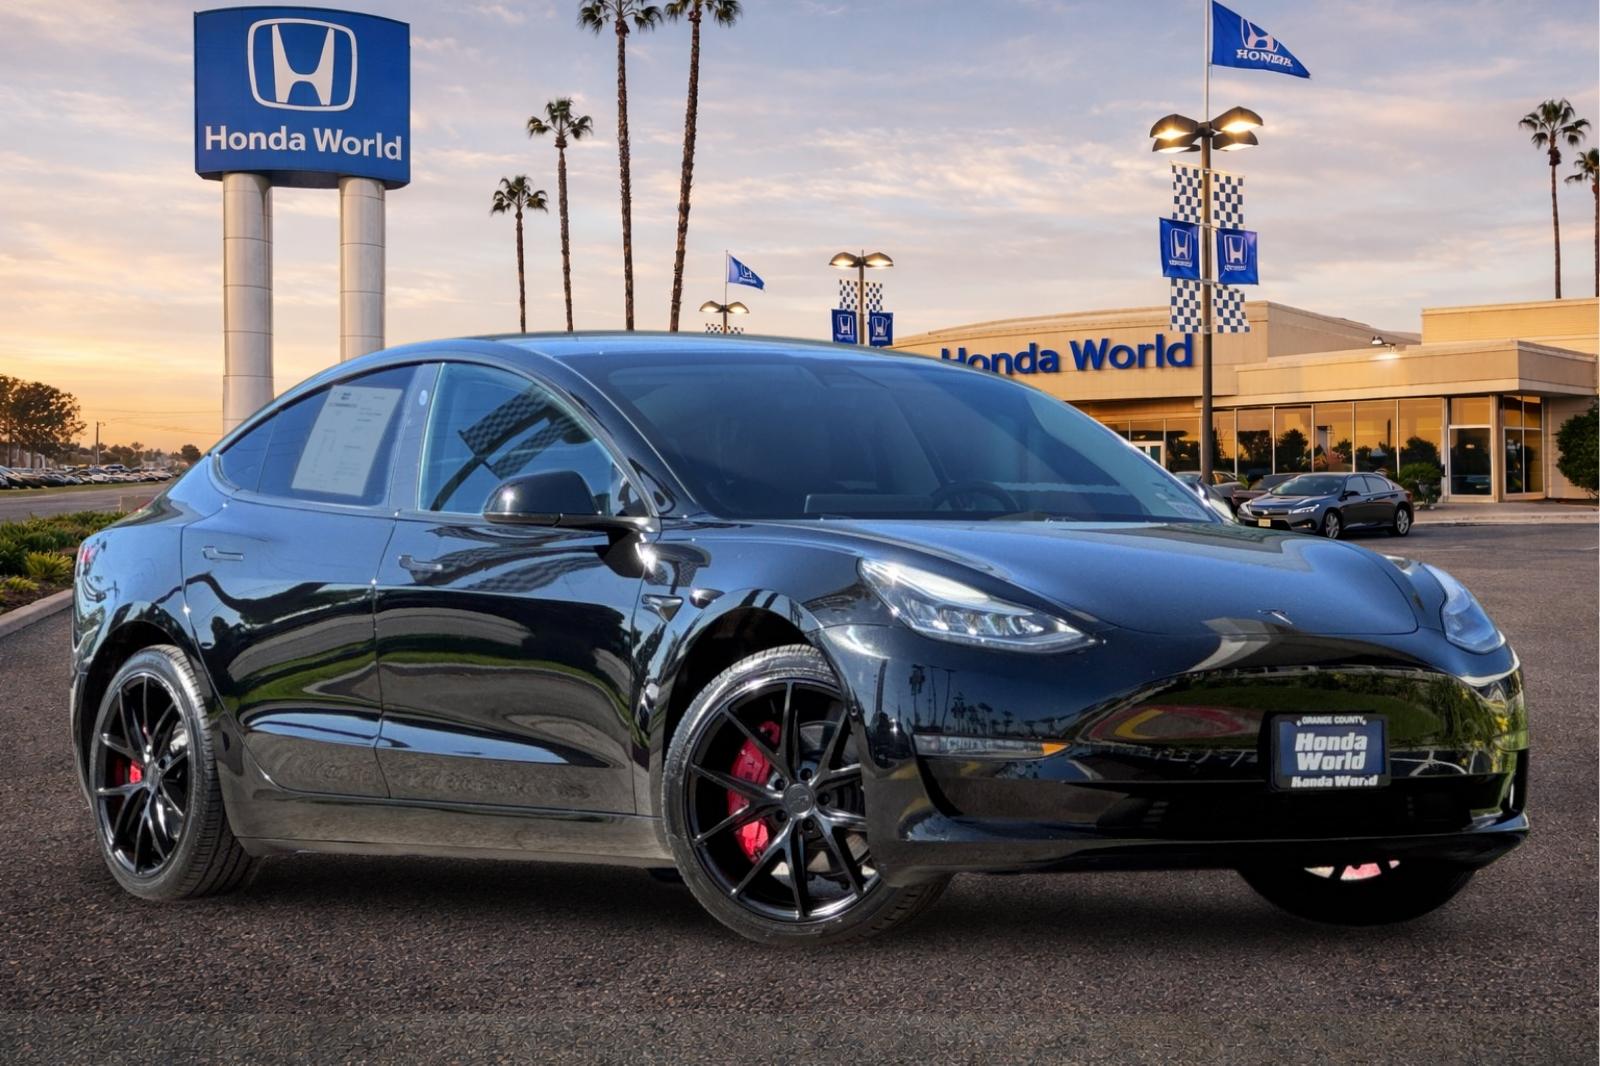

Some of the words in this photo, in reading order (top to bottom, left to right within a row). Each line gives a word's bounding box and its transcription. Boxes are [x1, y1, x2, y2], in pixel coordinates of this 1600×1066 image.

[205, 125, 306, 151] Honda
[313, 127, 402, 161] World
[1069, 333, 1194, 371] World
[1302, 715, 1333, 725] ORANGE
[1334, 715, 1364, 724] COUNTY
[1295, 732, 1368, 752] Honda
[1297, 751, 1366, 771] World
[1291, 775, 1334, 788] Honda
